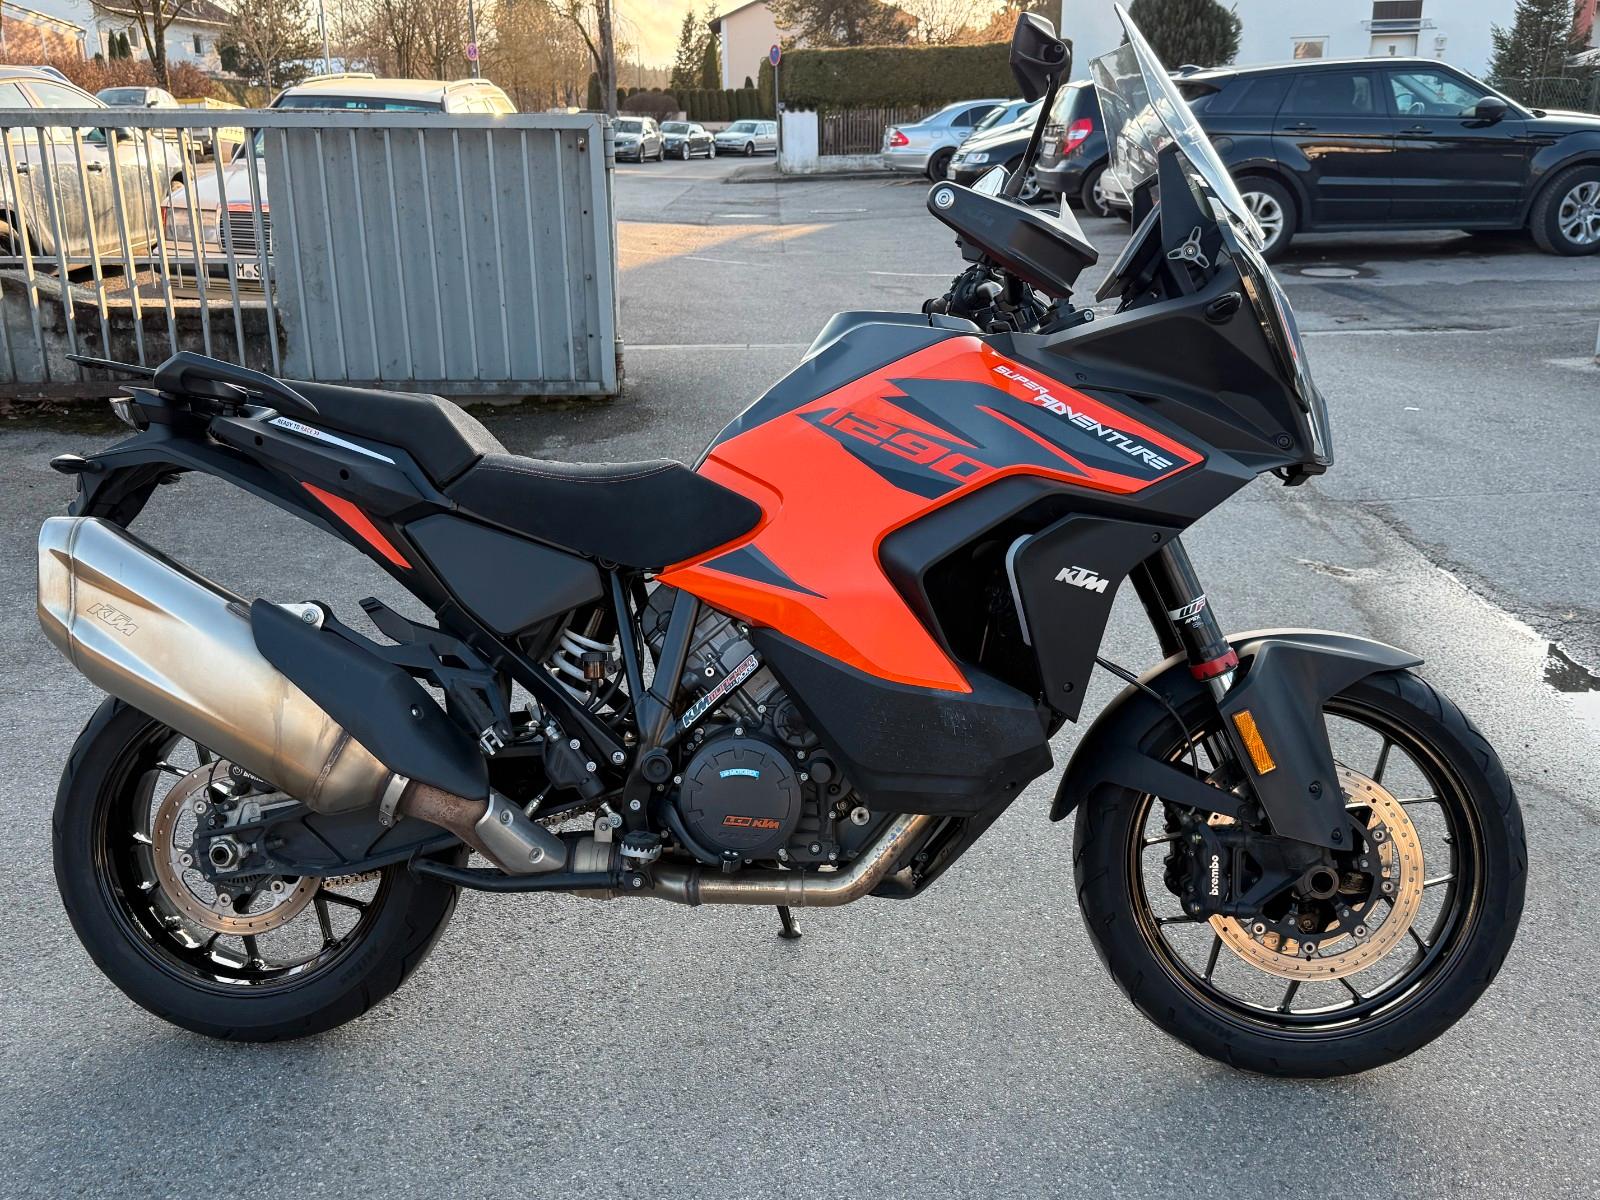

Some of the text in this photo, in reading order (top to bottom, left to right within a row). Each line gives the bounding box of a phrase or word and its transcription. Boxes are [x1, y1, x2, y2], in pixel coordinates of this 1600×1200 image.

[277, 419, 293, 428] READY
[300, 426, 313, 435] RACE
[993, 365, 1174, 471] SUPER ADVENTURE
[817, 408, 998, 483] 1290
[1054, 565, 1110, 594] KTM
[86, 602, 139, 637] KTM
[752, 818, 780, 830] KTM
[1208, 854, 1220, 896] brembo
